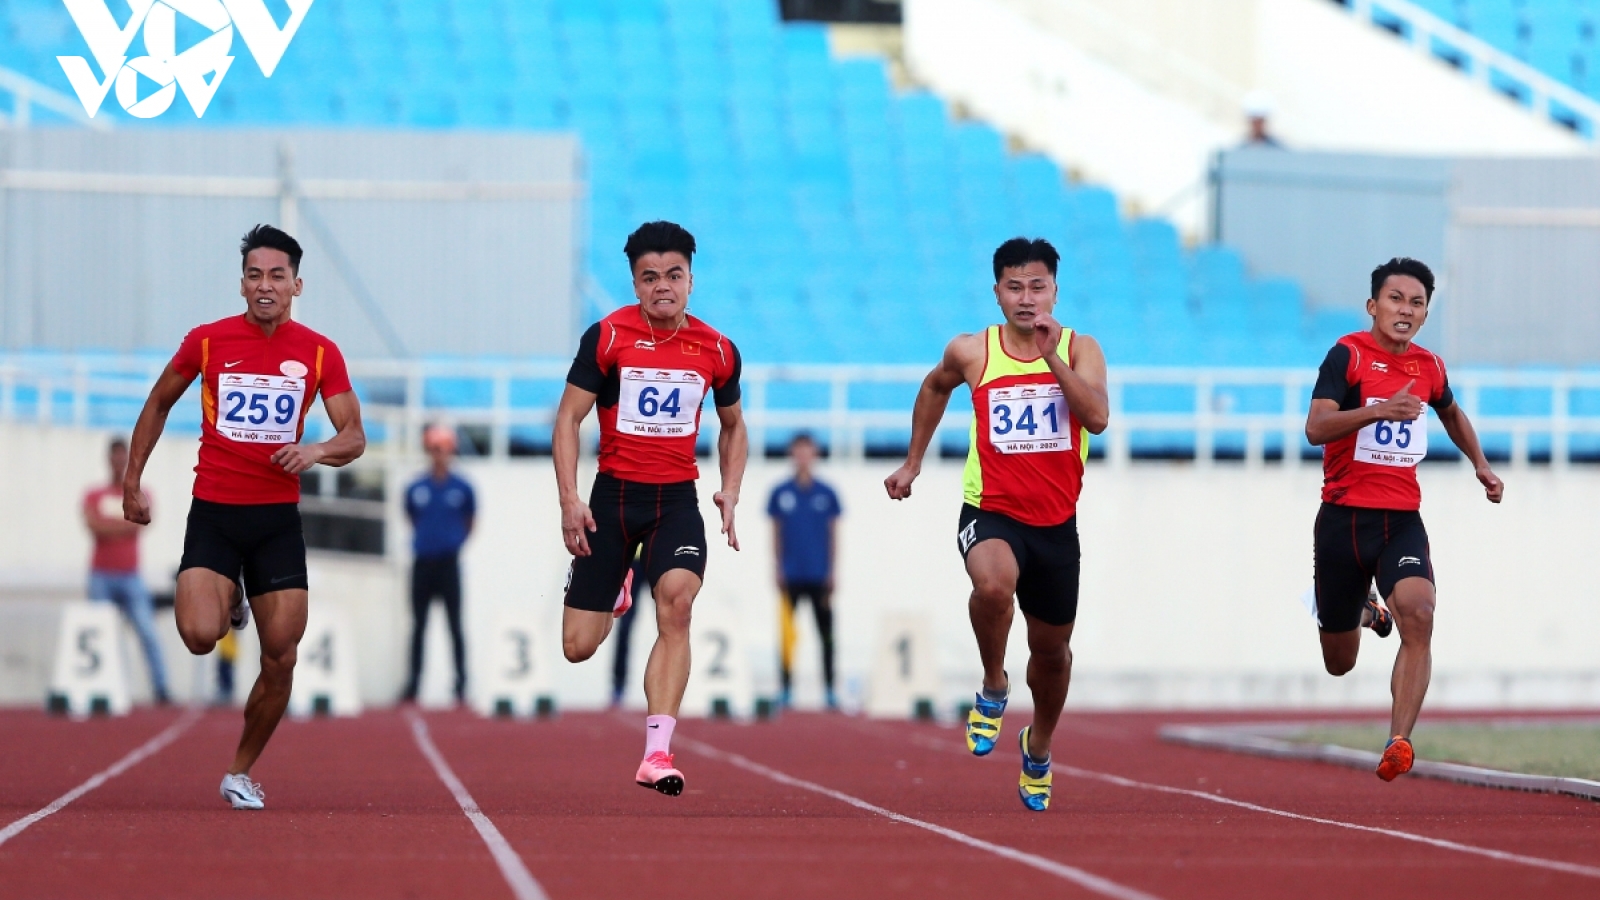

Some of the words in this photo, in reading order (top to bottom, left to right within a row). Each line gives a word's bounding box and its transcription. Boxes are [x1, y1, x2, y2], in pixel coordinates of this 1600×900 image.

[225, 391, 295, 425] 259
[638, 386, 681, 418] 64
[993, 402, 1058, 435] 341
[1375, 420, 1412, 449] 65
[77, 627, 101, 674] 5
[304, 630, 333, 676] 4
[504, 630, 532, 679] 3
[704, 631, 730, 676] 2
[892, 634, 914, 681] 1
